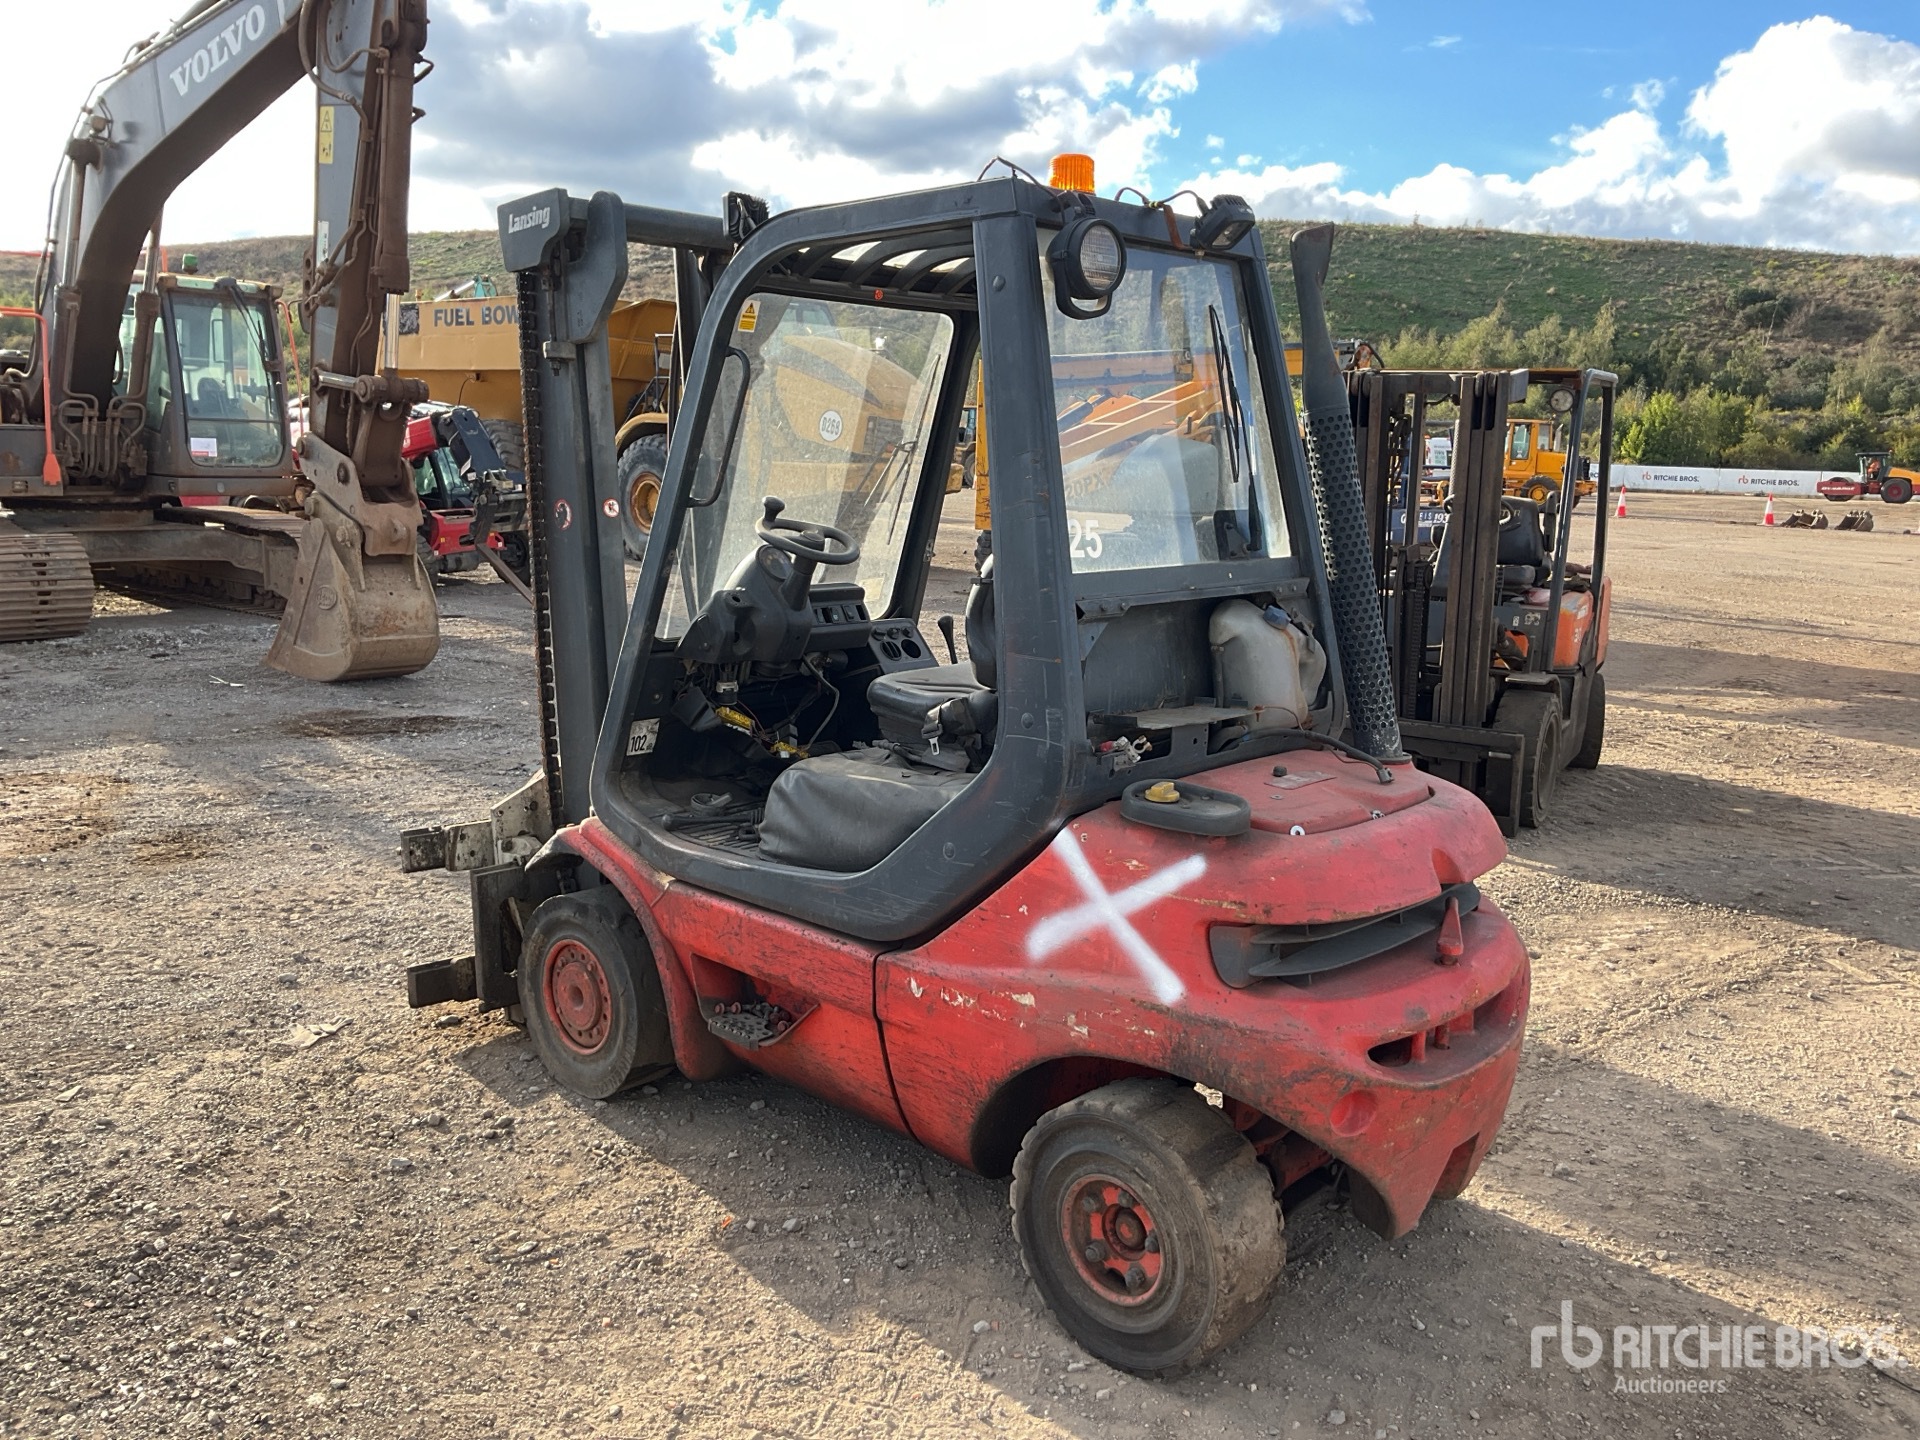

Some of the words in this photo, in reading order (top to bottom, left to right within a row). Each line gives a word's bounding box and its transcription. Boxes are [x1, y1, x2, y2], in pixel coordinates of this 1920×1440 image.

[169, 4, 265, 97] VOLVO
[508, 206, 550, 234] Lansing
[433, 308, 475, 327] FUEL
[1653, 474, 1678, 482] RITCHIE
[1679, 475, 1700, 483] BROS.
[1750, 478, 1777, 486] RITCHIE
[1778, 479, 1800, 487] BROS.
[1068, 519, 1103, 559] 25
[630, 734, 648, 752] 102
